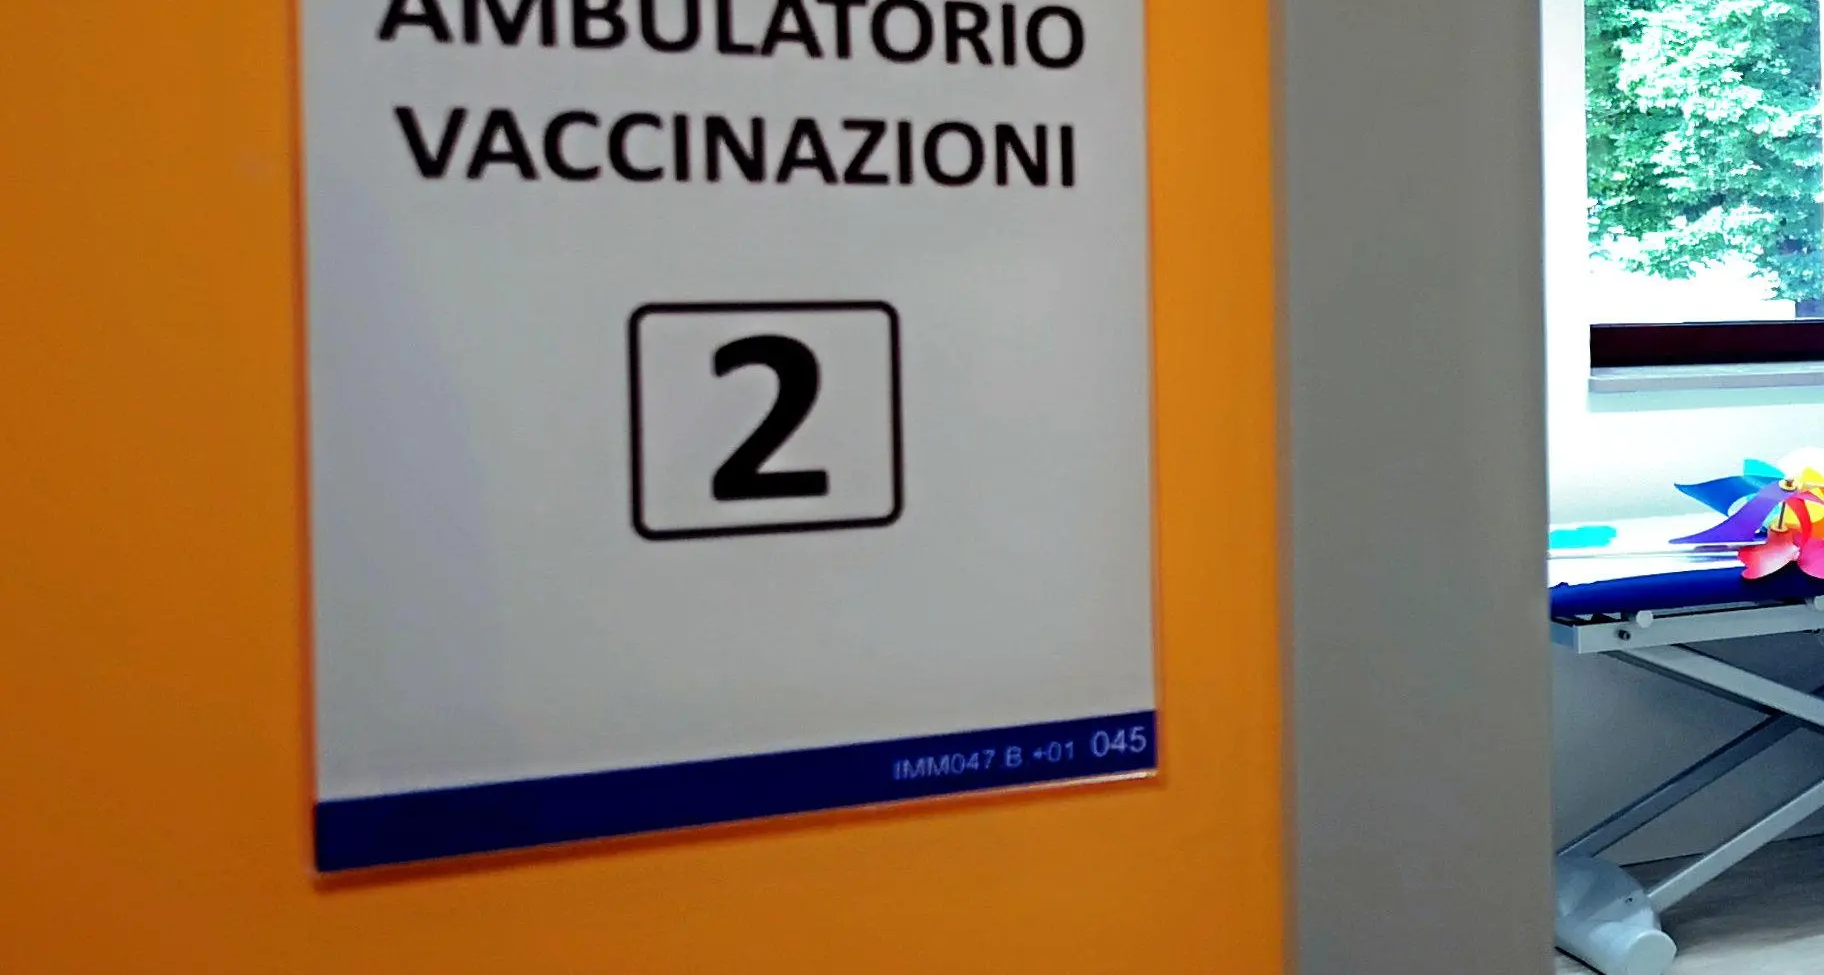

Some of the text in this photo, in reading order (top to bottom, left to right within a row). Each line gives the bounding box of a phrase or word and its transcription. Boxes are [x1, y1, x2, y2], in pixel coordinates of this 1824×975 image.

[392, 105, 1076, 189] VACCINAZIONI
[710, 333, 829, 502] 2
[1004, 746, 1024, 769] B
[1089, 725, 1148, 759] 045
